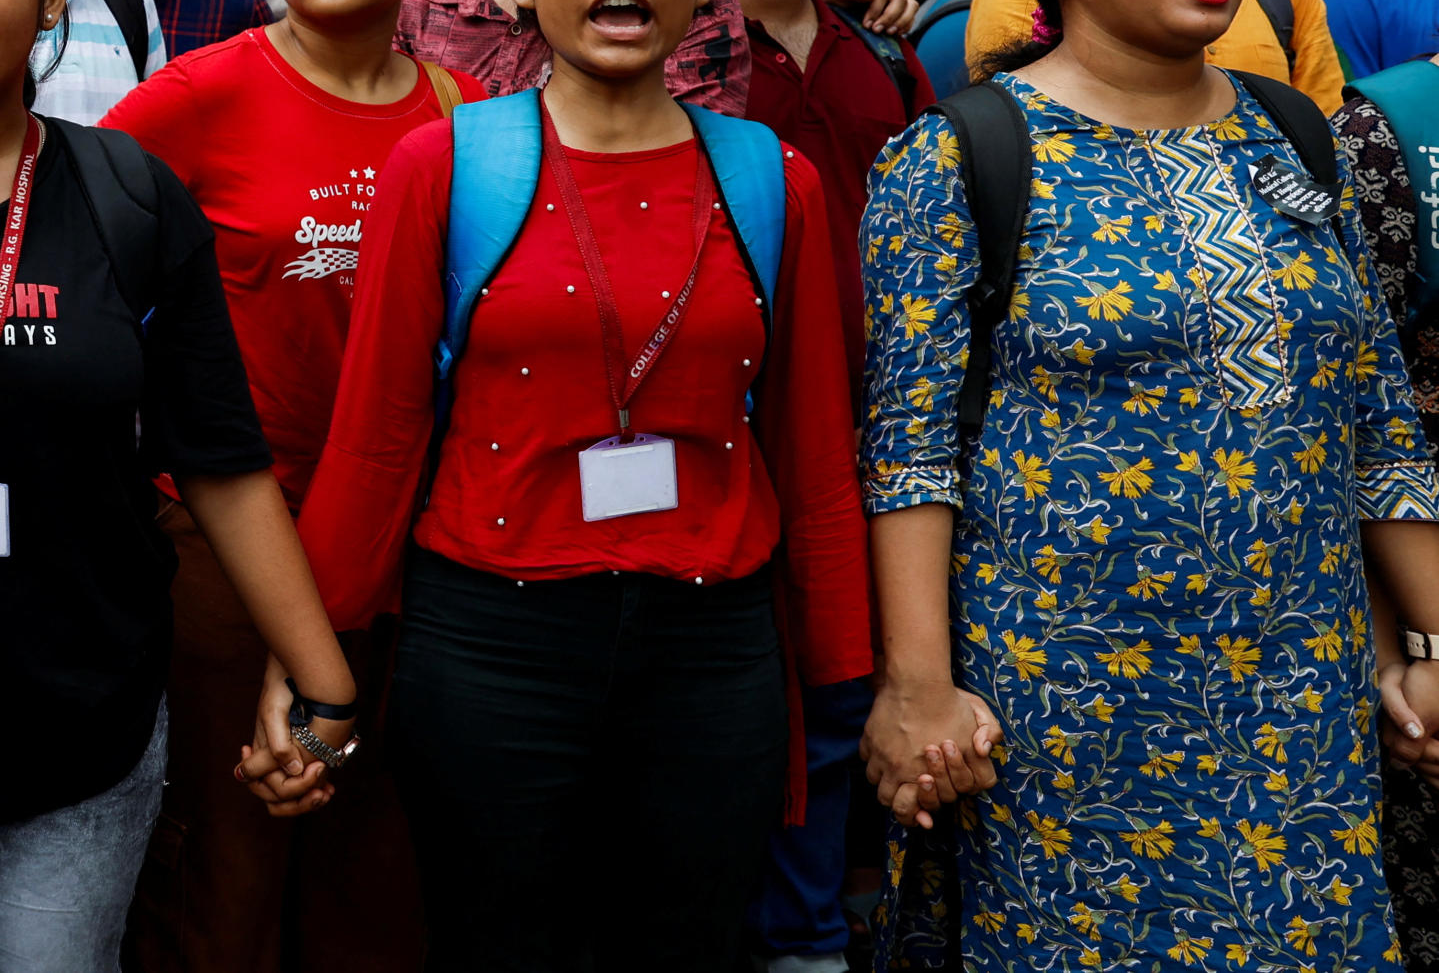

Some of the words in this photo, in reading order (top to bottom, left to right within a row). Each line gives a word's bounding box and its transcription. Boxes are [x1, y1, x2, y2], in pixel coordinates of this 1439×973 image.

[16, 153, 35, 204] HOSPITAL
[309, 183, 350, 201] BUILT
[10, 206, 24, 230] KAR
[295, 216, 362, 248] Speed
[5, 233, 18, 255] R.G.
[630, 325, 670, 378] COLLEGE
[667, 306, 680, 324] OF
